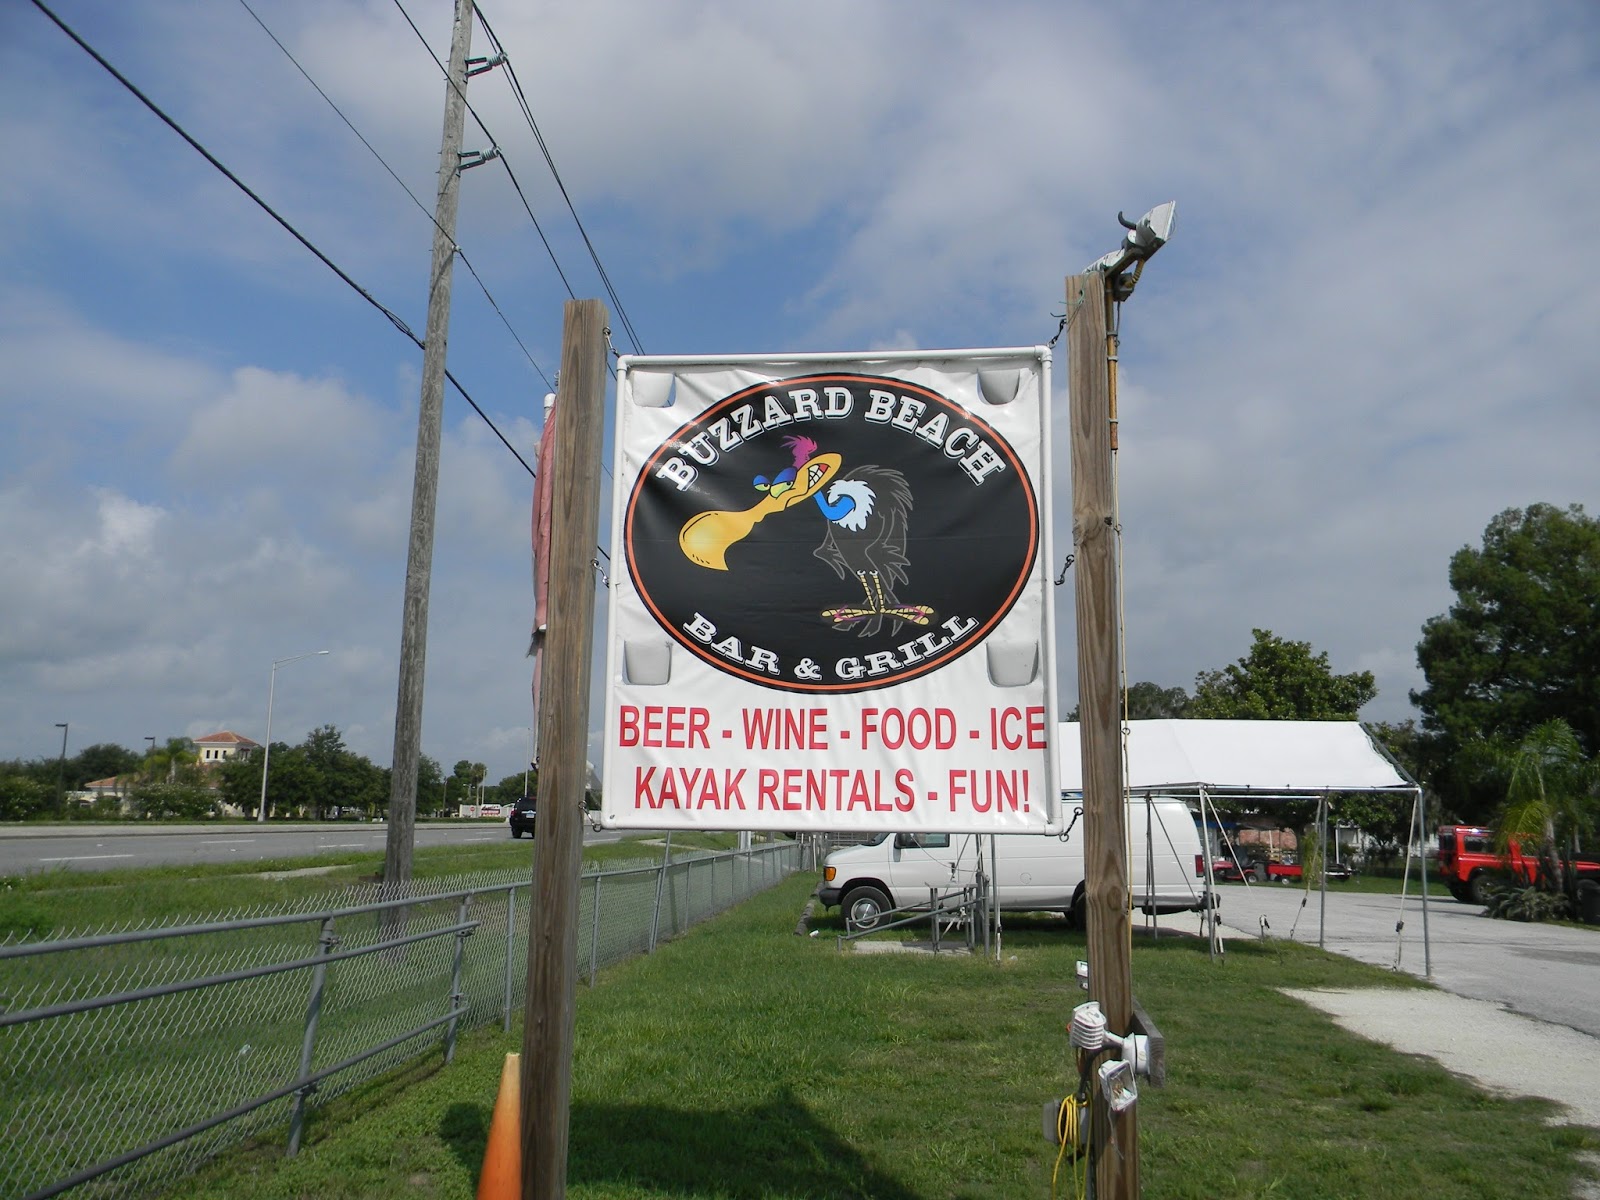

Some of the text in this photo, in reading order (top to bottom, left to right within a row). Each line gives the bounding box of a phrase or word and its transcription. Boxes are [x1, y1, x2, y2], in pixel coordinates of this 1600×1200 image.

[655, 386, 1007, 493] BUZZARD BEACH
[683, 612, 980, 681] BAR & GRILL
[619, 705, 710, 749] BEER
[742, 708, 829, 751] WINE
[861, 707, 957, 751] FOOD
[990, 706, 1048, 751] ICE
[635, 767, 747, 810] KAYAK
[758, 769, 915, 812] RENTALS
[949, 769, 1031, 813] FUN!
